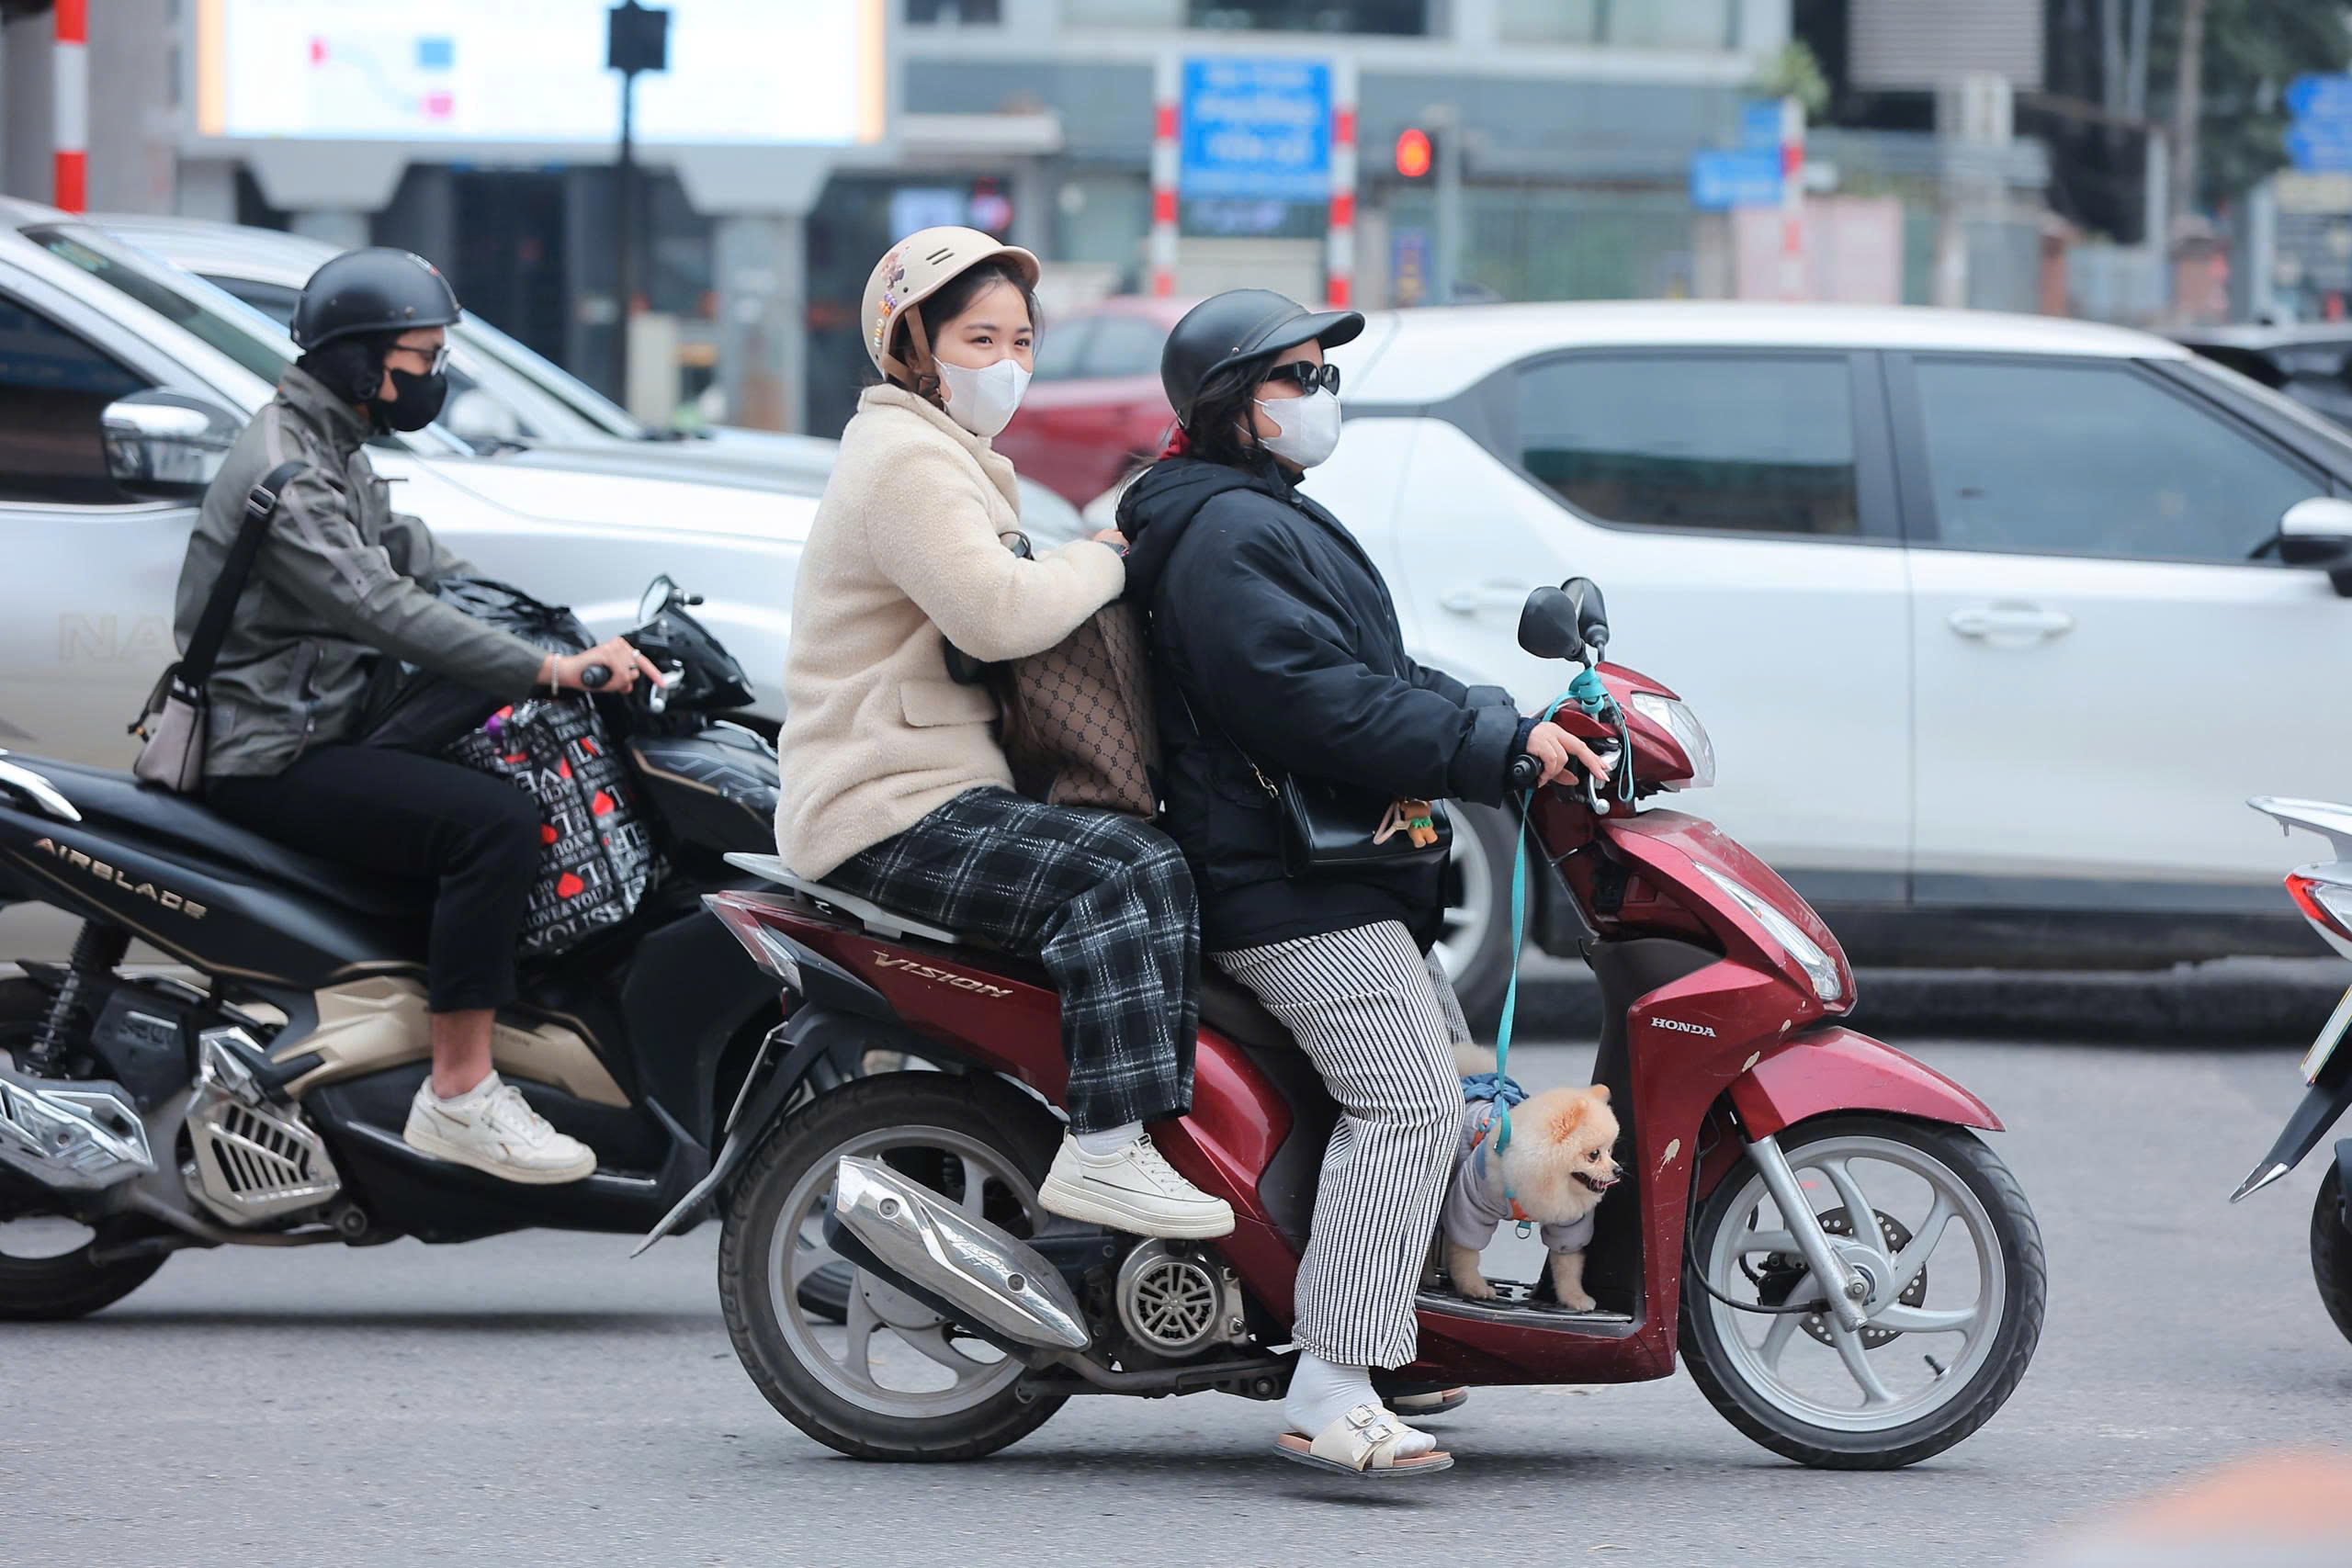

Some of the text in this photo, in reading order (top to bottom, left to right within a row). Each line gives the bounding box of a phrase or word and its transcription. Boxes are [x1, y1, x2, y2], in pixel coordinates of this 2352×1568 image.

[34, 837, 209, 919] AIRBLADE
[873, 949, 1013, 998] VISION
[1651, 1017, 1717, 1038] HONDA
